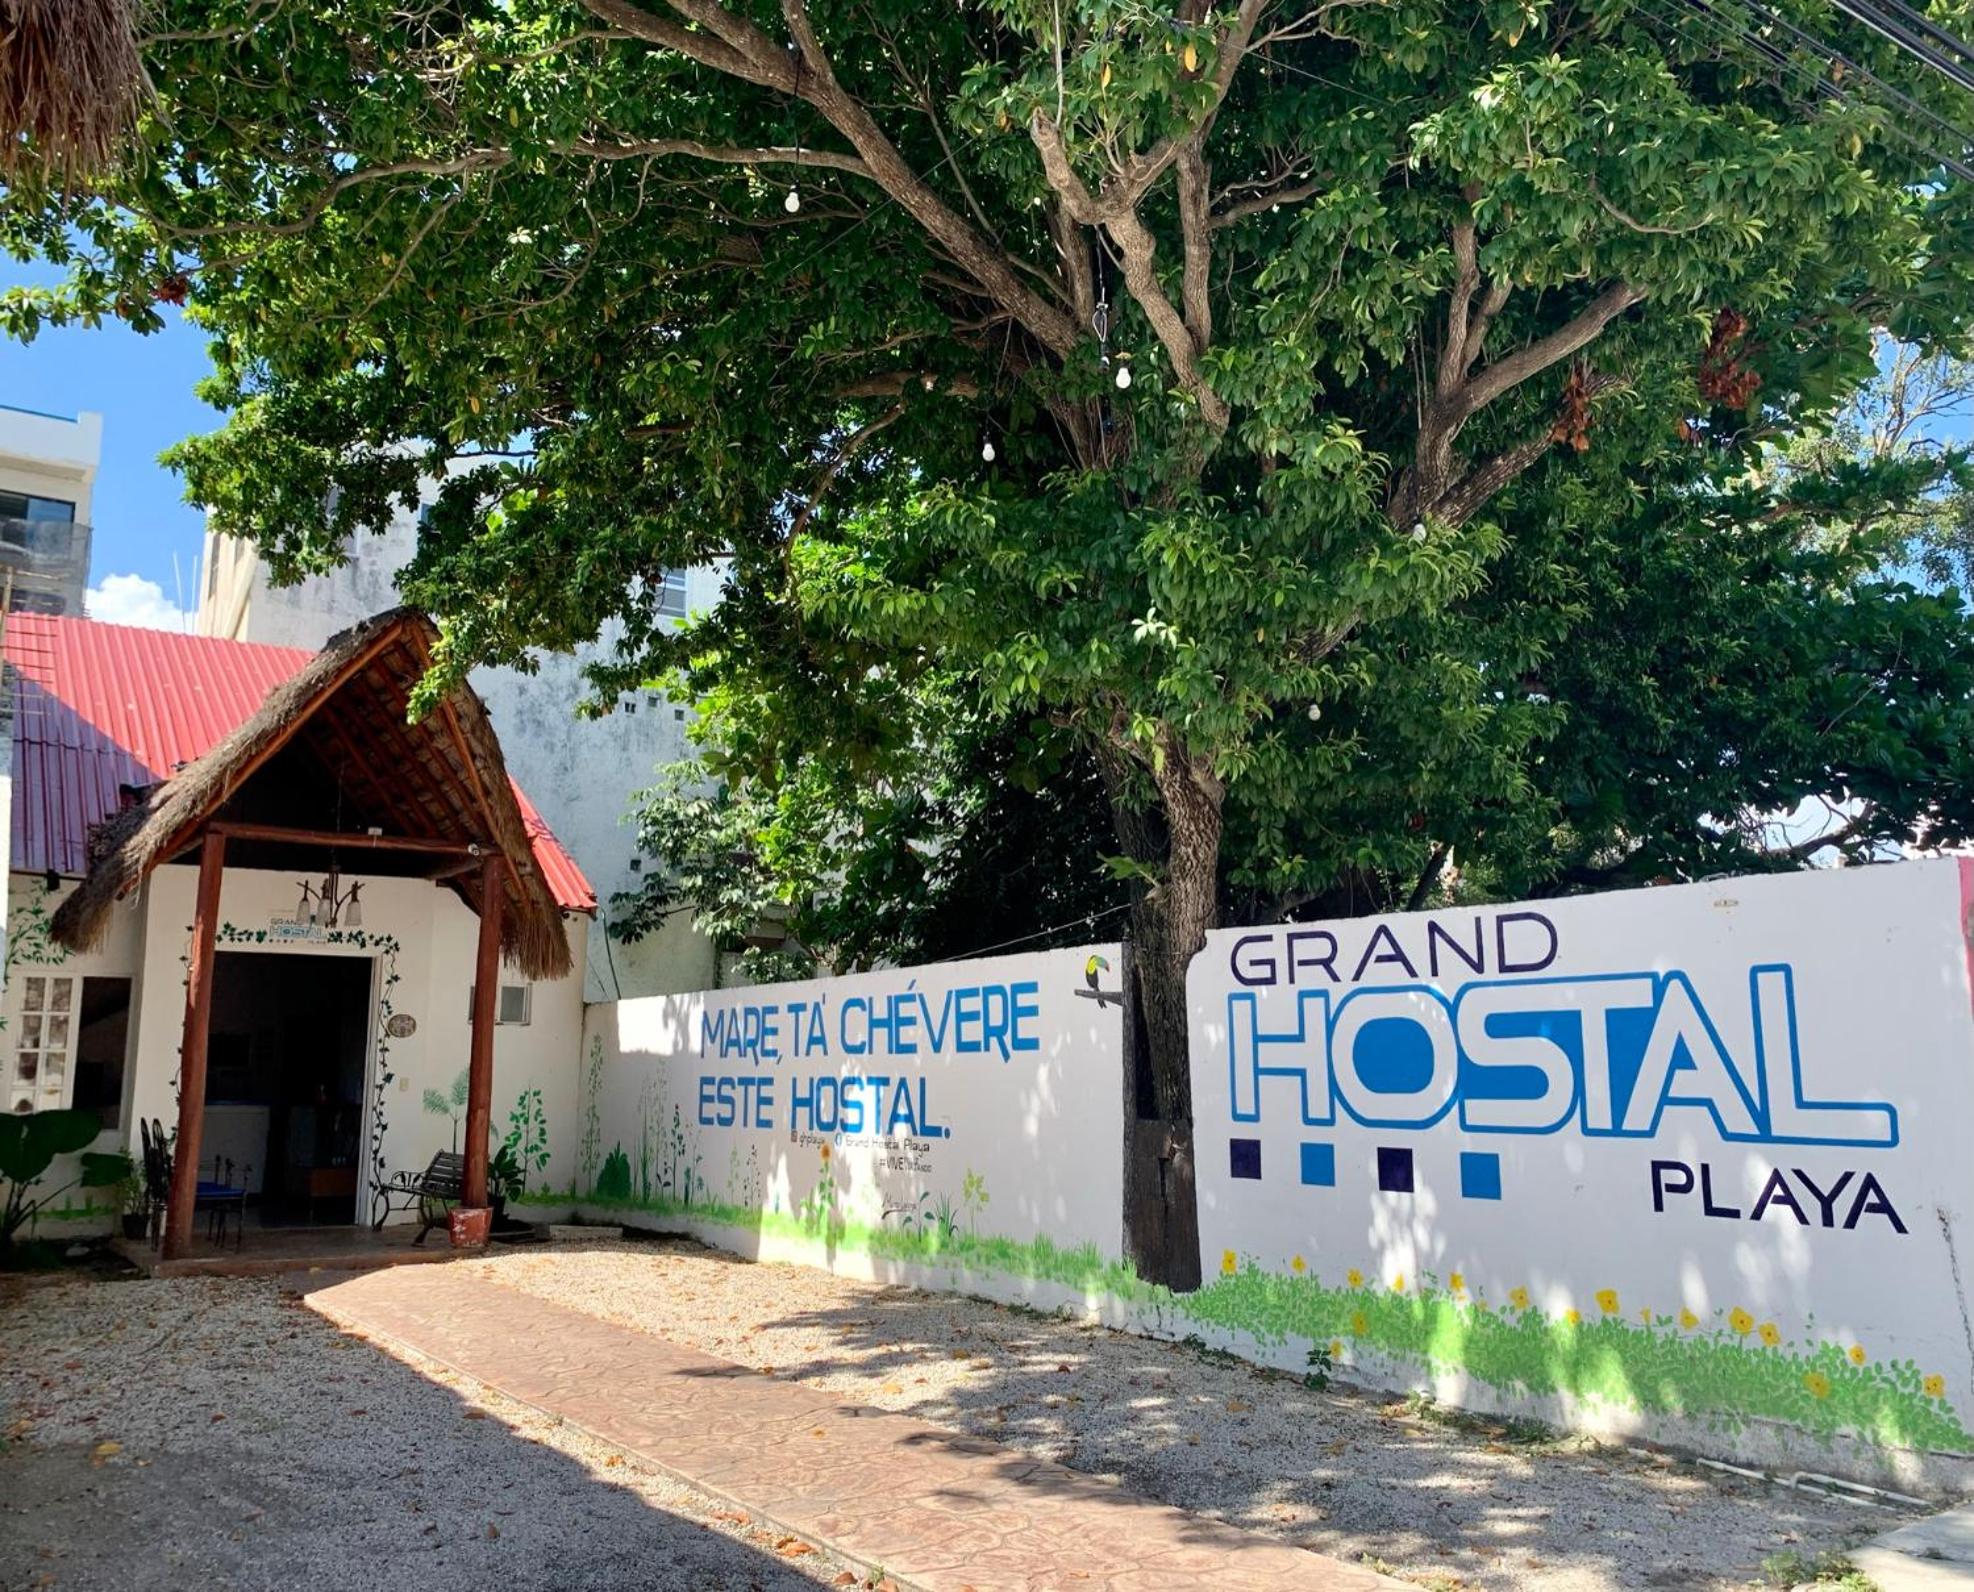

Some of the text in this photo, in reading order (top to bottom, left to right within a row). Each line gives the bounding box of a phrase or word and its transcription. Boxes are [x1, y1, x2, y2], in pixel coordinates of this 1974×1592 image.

[1231, 911, 1558, 985] GRAND
[700, 1005, 783, 1066] MARE,
[840, 978, 1040, 1063] CHÉVERE
[1228, 962, 1900, 1149] HOSTAL
[698, 1076, 951, 1139] ESTE HOSTAL.
[903, 1138, 930, 1157] Playa
[1650, 1159, 1909, 1234] PLAYA
